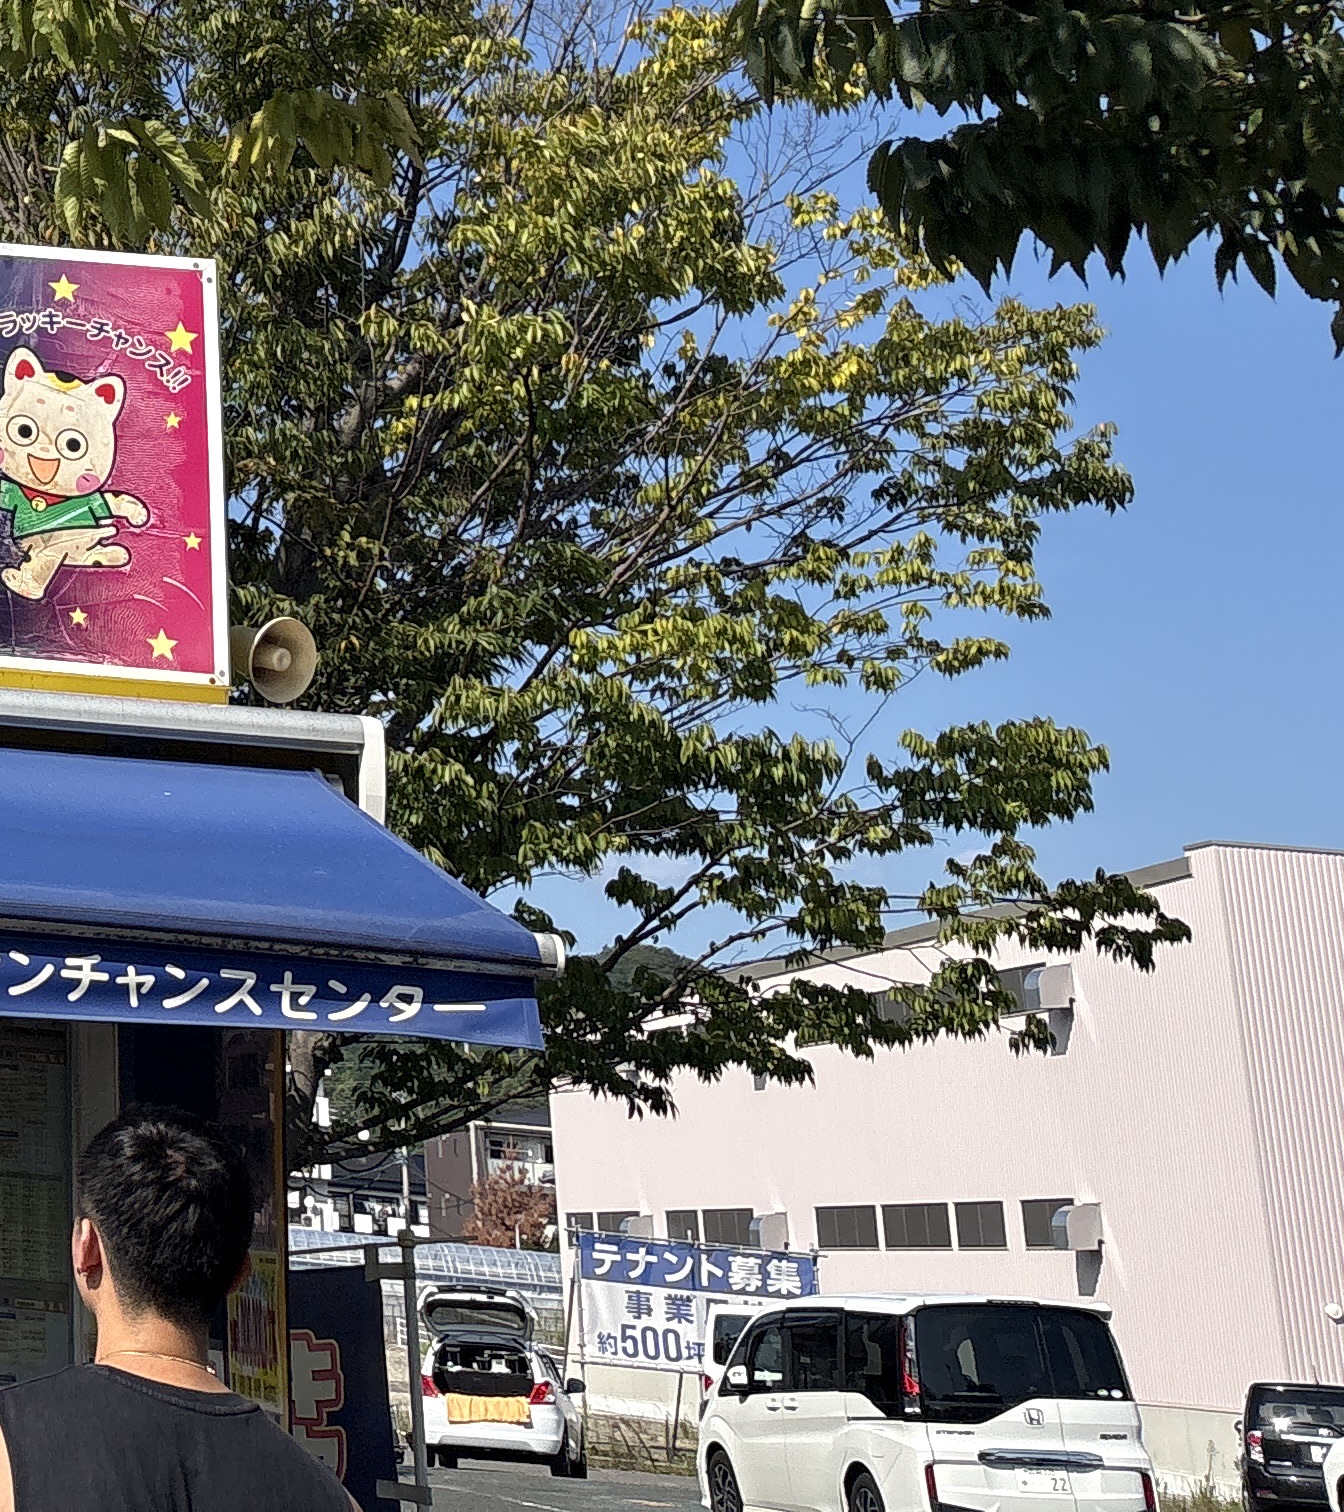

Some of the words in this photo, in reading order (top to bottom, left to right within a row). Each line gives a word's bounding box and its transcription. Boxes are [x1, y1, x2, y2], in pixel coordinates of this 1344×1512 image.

[591, 1242, 803, 1296] テナント募集
[596, 1323, 706, 1364] 約500坪
